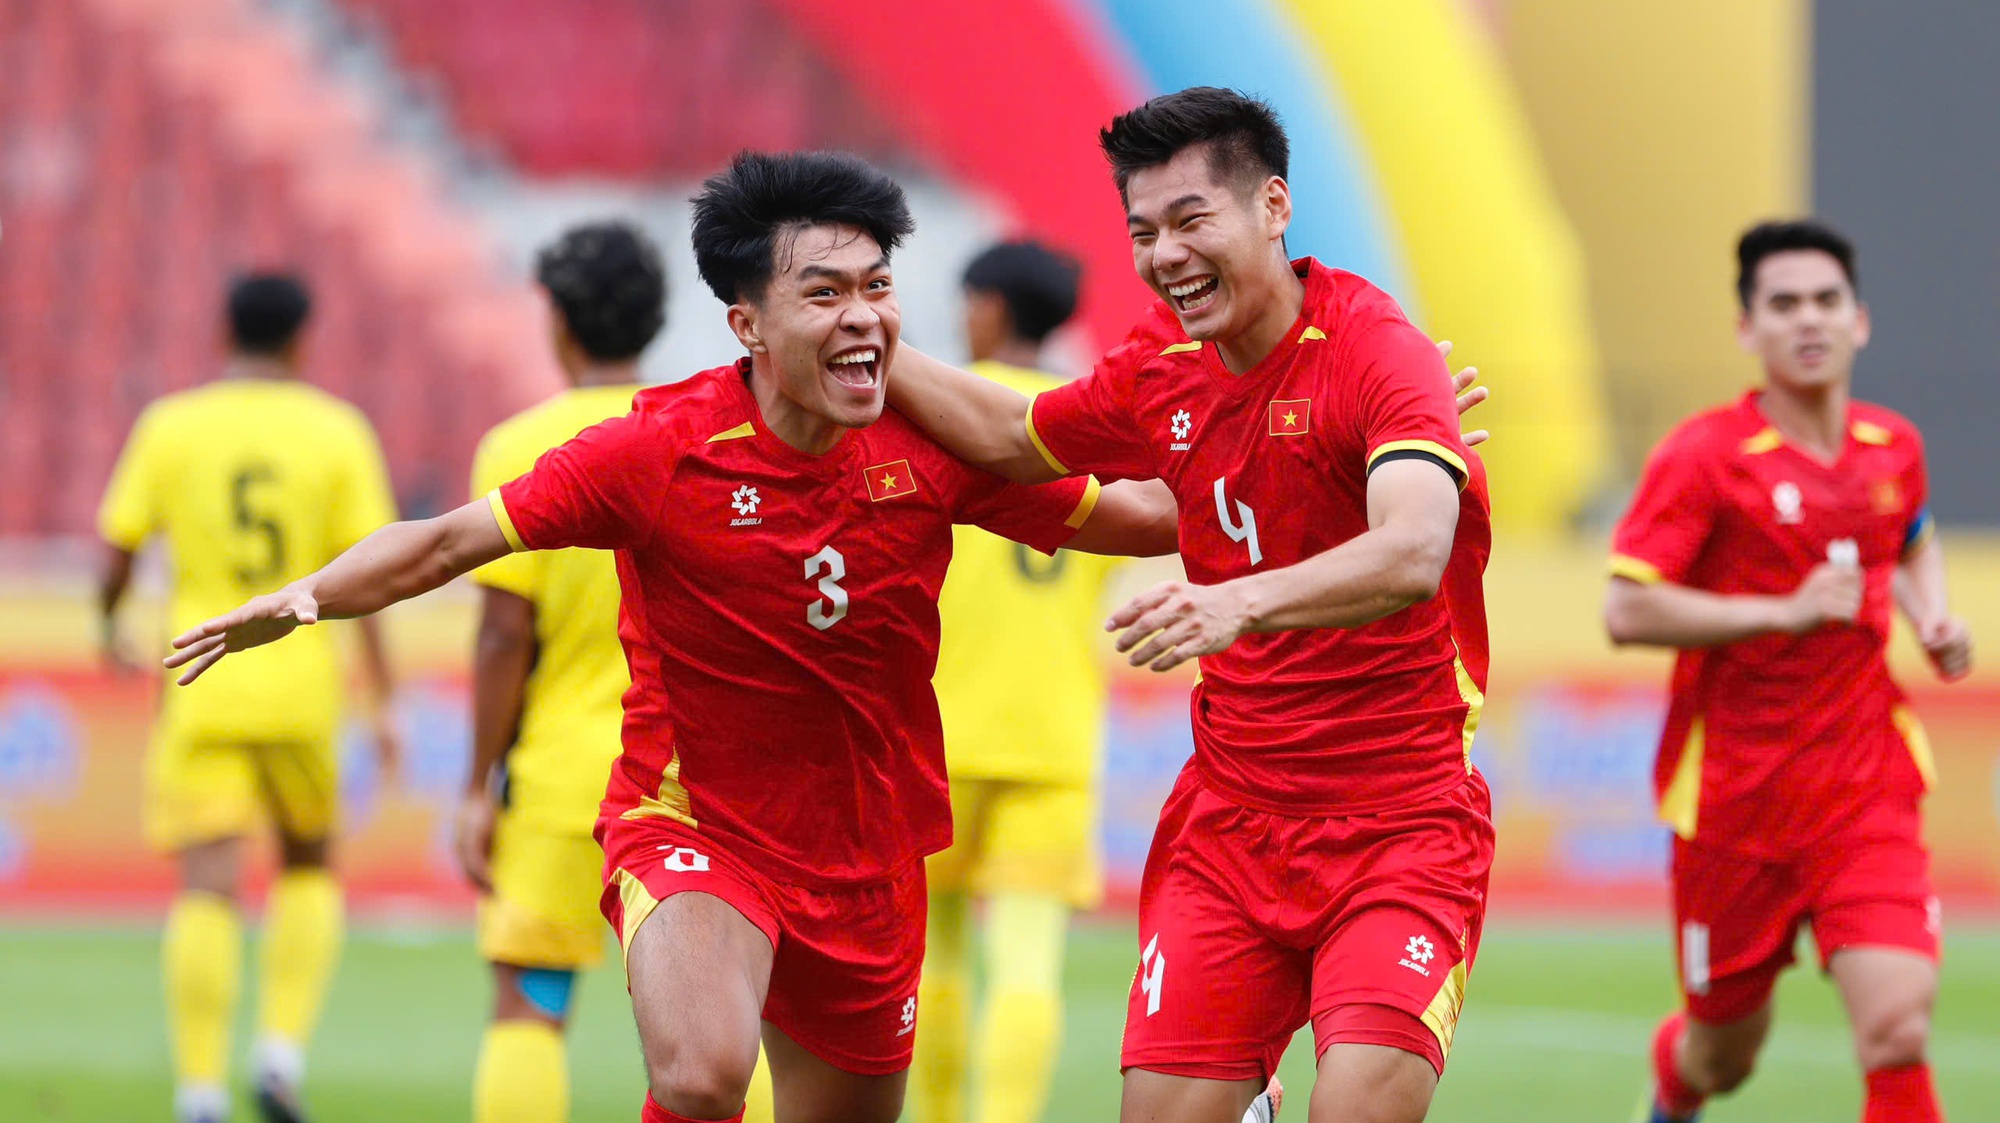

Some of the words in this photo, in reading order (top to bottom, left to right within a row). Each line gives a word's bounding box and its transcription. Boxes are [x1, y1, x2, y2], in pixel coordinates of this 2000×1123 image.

[231, 460, 287, 586] 5
[1213, 475, 1264, 567] 4
[803, 544, 849, 631] 3
[1141, 931, 1167, 1018] 4
